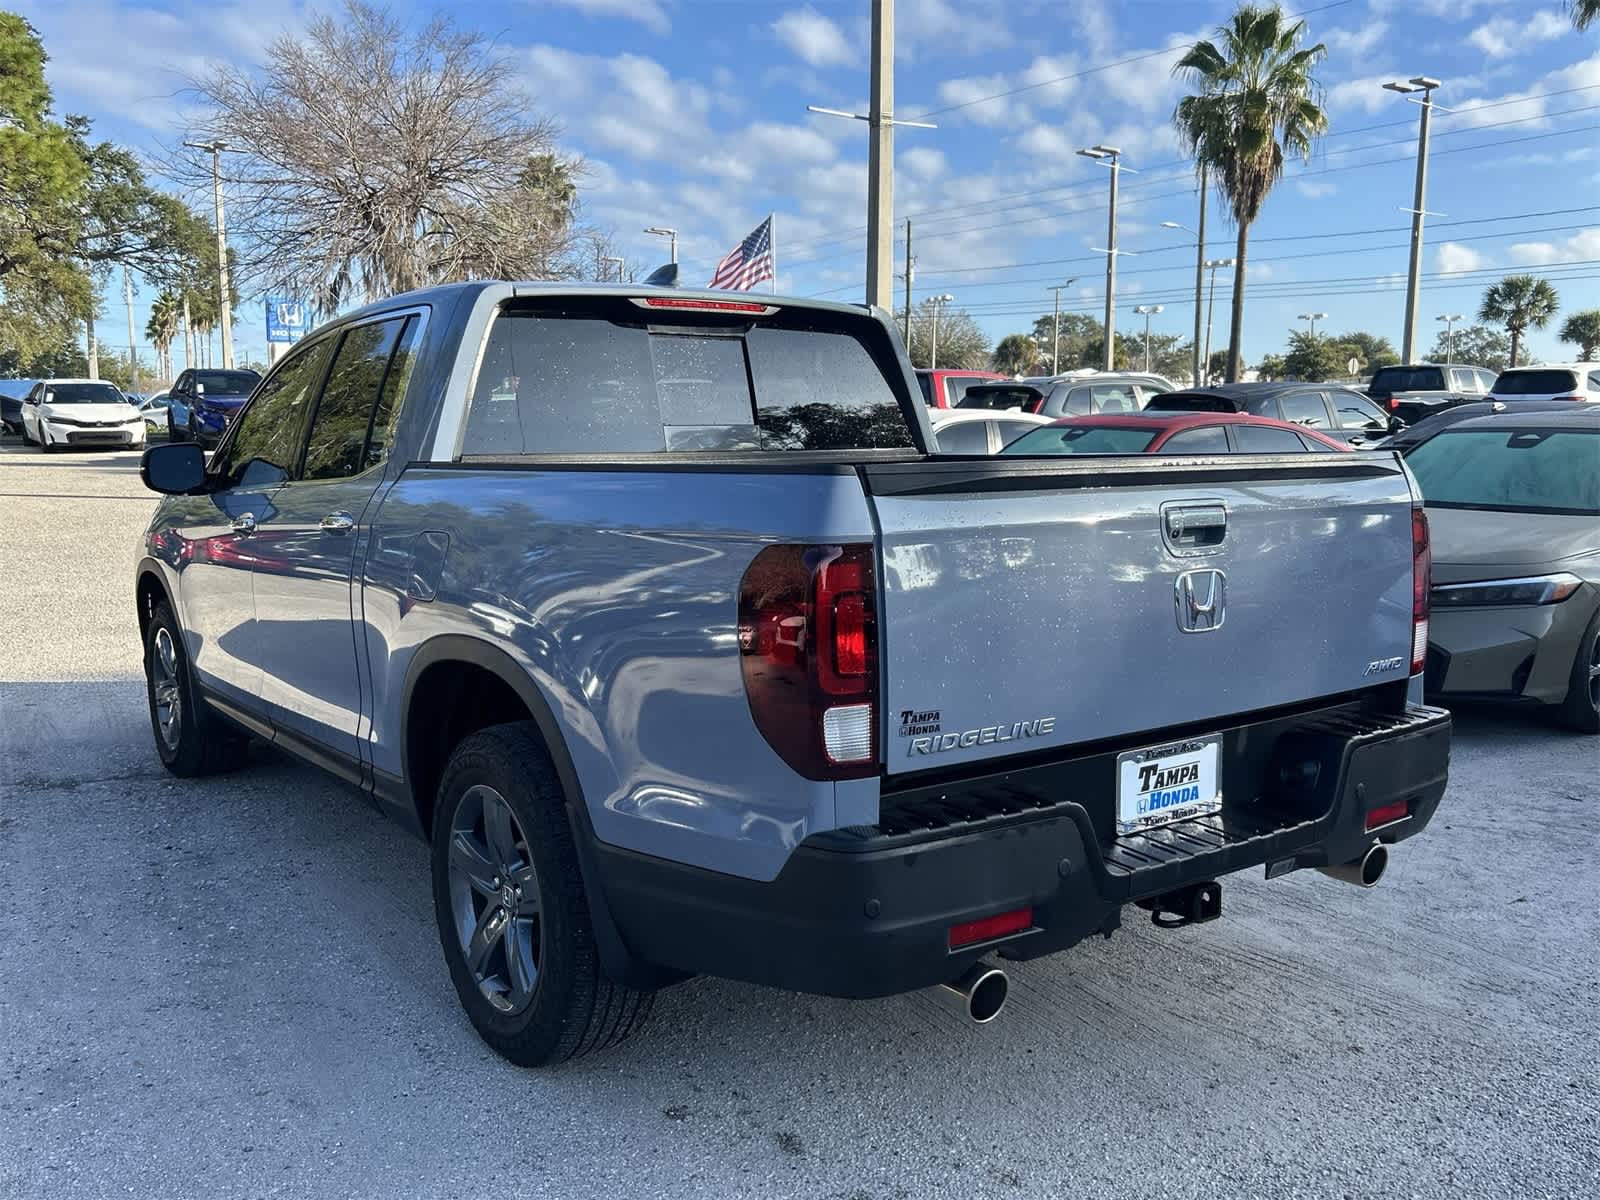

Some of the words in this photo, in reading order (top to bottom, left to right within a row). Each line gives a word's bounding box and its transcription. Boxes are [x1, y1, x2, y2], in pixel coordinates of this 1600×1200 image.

[1364, 656, 1404, 676] AWD
[901, 710, 940, 725] TAMPA
[908, 723, 940, 736] HONDA
[908, 717, 1057, 756] RIDGELINE
[1138, 763, 1199, 791] TAMPA
[1149, 785, 1199, 811] HONDA
